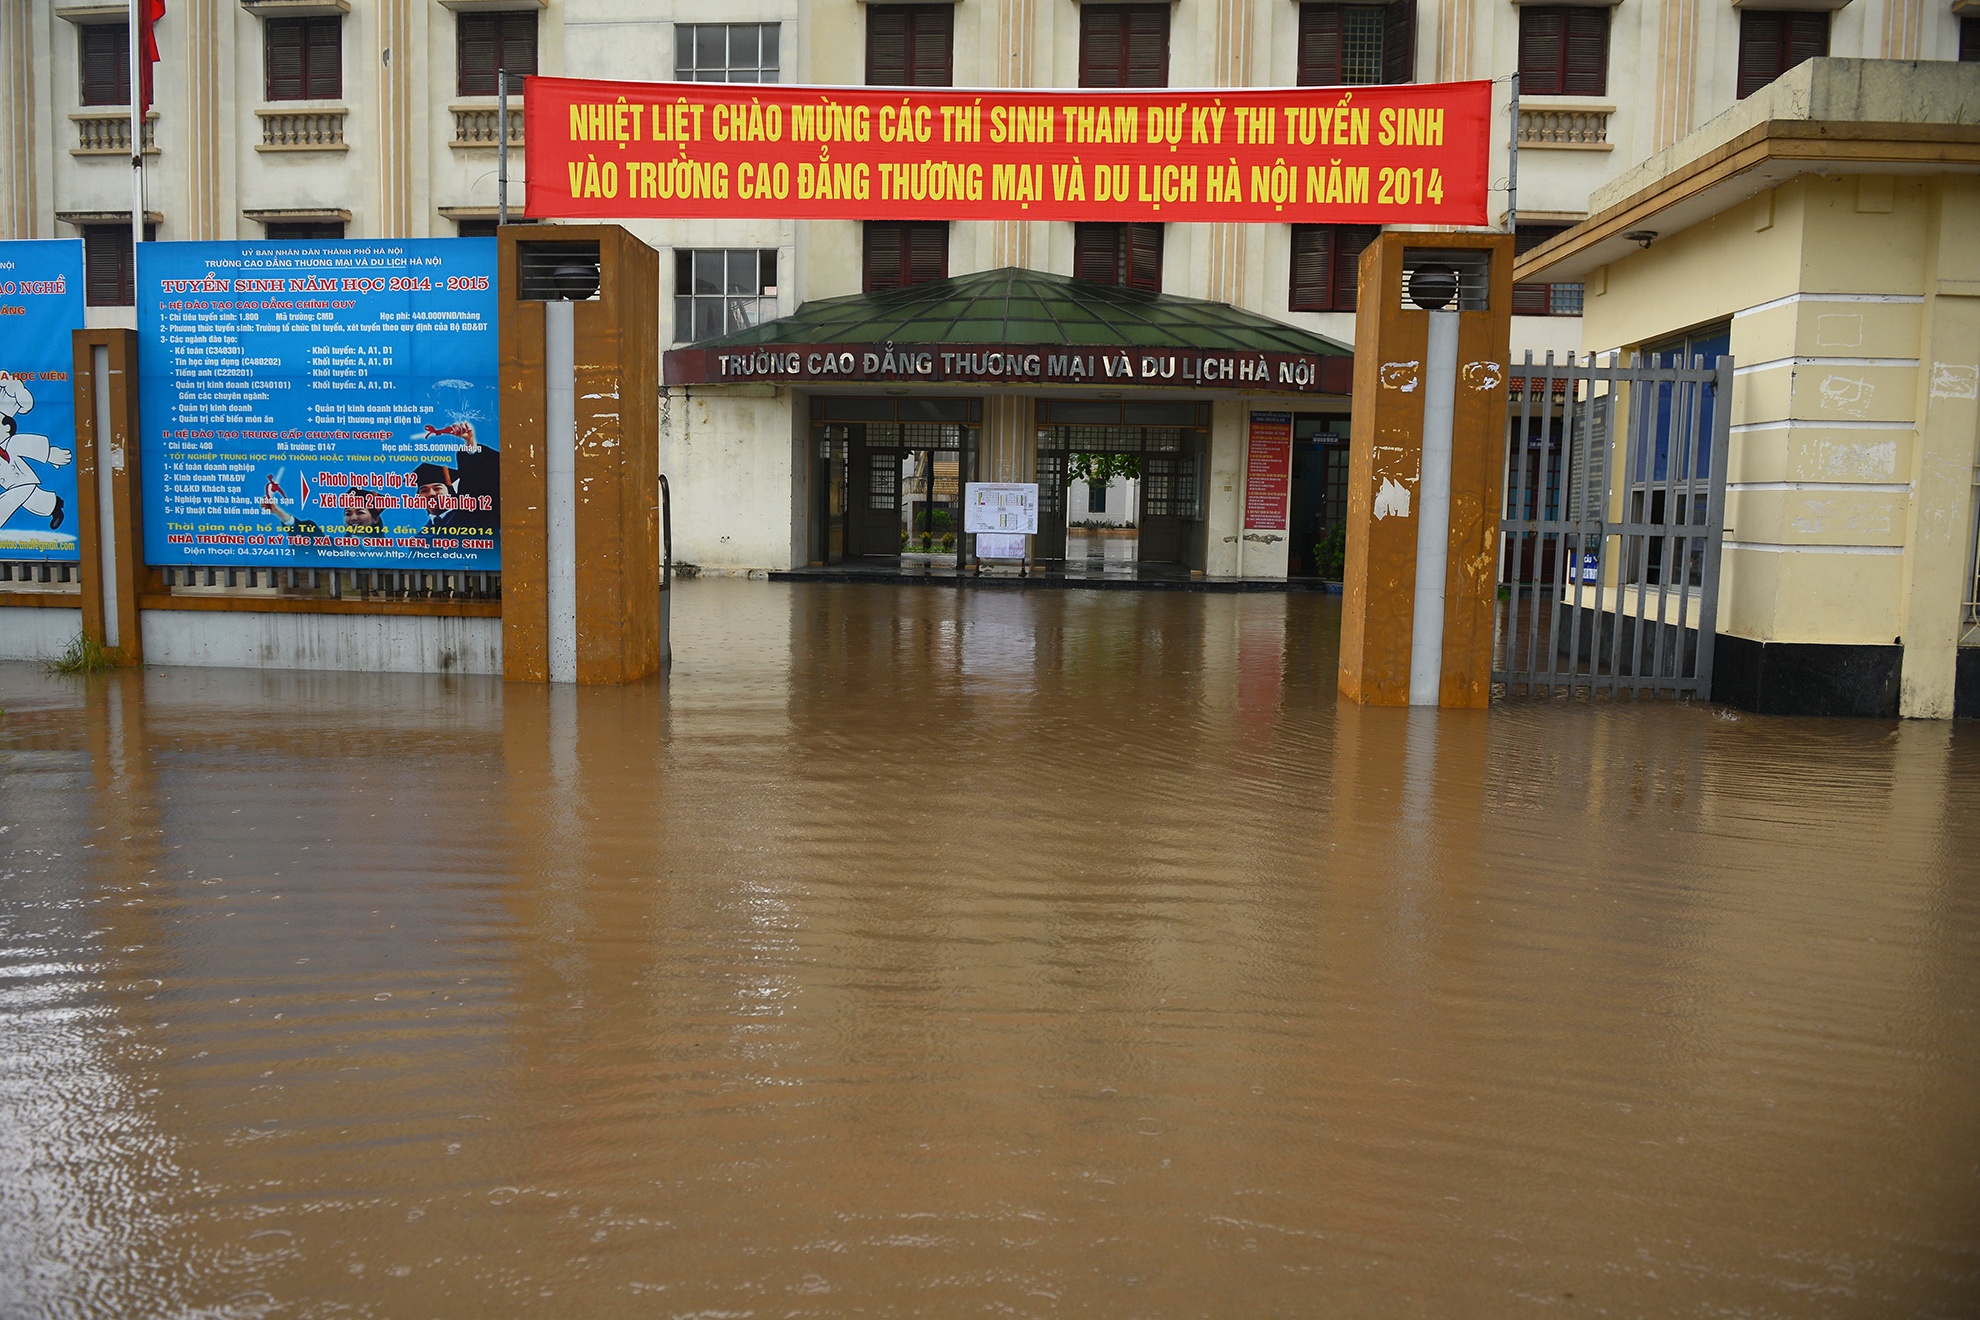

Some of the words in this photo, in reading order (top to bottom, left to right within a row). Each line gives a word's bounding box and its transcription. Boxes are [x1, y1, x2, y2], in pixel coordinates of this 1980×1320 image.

[570, 96, 644, 149] NHIỆT
[652, 97, 704, 149] LIỆT
[713, 97, 782, 142] CHÀO
[792, 96, 870, 142] MỪNG
[879, 98, 931, 142] CÁC
[940, 98, 981, 142] THÍ
[990, 106, 1053, 143] SINH
[1063, 106, 1137, 143] THAM
[1147, 102, 1188, 152] DỰ
[1192, 99, 1226, 144] KỲ
[1234, 108, 1275, 145] THI
[1284, 92, 1369, 146] TUYỂN
[1379, 108, 1444, 146] SINH
[568, 154, 617, 198] VÀO
[626, 152, 729, 199] TRƯỜNG
[738, 162, 789, 199] CAO
[797, 144, 869, 200] ĐẲNG
[878, 160, 982, 201] THƯƠNG
[992, 164, 1042, 209] MẠI
[1052, 157, 1085, 201] VÀ
[1094, 165, 1129, 202] DU
[1139, 165, 1197, 210] LỊCH
[1207, 158, 1242, 202] HÀ
[1251, 158, 1297, 210] NỘI
[1306, 158, 1369, 203] NĂM
[1378, 167, 1443, 204] 2014
[302, 248, 321, 256] DÂN
[323, 248, 352, 256] THÀNH
[354, 247, 372, 255] PHỐ
[388, 247, 403, 256] NỘI
[0, 261, 15, 271] NỘI
[205, 259, 242, 268] TRƯỜNG
[244, 260, 264, 268] CAO
[266, 256, 293, 268] ĐẲNG
[295, 259, 333, 267] THƯƠNG
[335, 259, 353, 268] MẠI
[355, 257, 369, 267] VÀ
[387, 258, 408, 267] LỊCH
[410, 257, 423, 266] HÀ
[426, 257, 442, 267] NỘI
[19, 273, 66, 295] NGHỀ
[161, 272, 230, 293] TUYỂN
[234, 279, 285, 292] SINH
[289, 275, 338, 292] NĂM
[341, 277, 385, 294] HỌC
[389, 277, 431, 291] 2014
[447, 276, 489, 291] 2015
[169, 300, 183, 311] HỆ
[184, 300, 209, 310] ĐÀO
[211, 301, 233, 311] TẠO
[235, 301, 259, 309] CAO
[261, 297, 293, 309] ĐẲNG
[295, 299, 329, 309] CHÍNH
[331, 300, 356, 309] QUY
[718, 348, 801, 375] TRƯỜNG
[807, 352, 855, 375] CAO
[863, 341, 932, 375] ĐẲNG
[941, 351, 1040, 377] THƯƠNG
[1048, 354, 1094, 382] MẠI
[1102, 350, 1134, 377] VÀ
[1141, 356, 1176, 378] DU
[1182, 358, 1233, 384] LỊCH
[1239, 355, 1270, 382] HÀ
[1279, 358, 1315, 389] NỘI
[175, 430, 188, 440] HỆ
[190, 430, 215, 438] ĐÀO
[216, 430, 239, 440] TẠO
[241, 430, 278, 439] TRUNG
[280, 428, 303, 439] CẤP
[305, 430, 350, 440] CHUYÊN
[352, 430, 393, 441] NGHIỆP
[188, 453, 217, 461] NGHIỆP
[250, 454, 267, 462] HỌC
[270, 453, 286, 461] PHỔ
[320, 454, 343, 462] HOẶC
[373, 454, 386, 463] ĐỘ
[420, 455, 452, 463] ĐƯƠNG
[318, 472, 348, 487] Photo
[349, 472, 369, 490] học
[370, 472, 384, 490] bạ
[385, 472, 402, 489] lớp
[404, 473, 418, 487] 12
[319, 493, 337, 508] Xét
[338, 490, 365, 508] điểm
[366, 493, 374, 509] 2
[374, 493, 400, 509] môn:
[402, 493, 428, 509] Toán
[437, 494, 458, 510] Văn
[459, 494, 476, 512] lớp
[478, 495, 492, 510] 12
[167, 523, 194, 531] Thời
[198, 523, 225, 533] gian
[229, 523, 253, 534] nộp
[257, 523, 272, 532] hồ
[276, 524, 294, 532] sơ:
[298, 524, 316, 533] Từ
[319, 525, 389, 534] 18/04/2014
[393, 525, 416, 535] đến
[421, 526, 493, 536] 31/10/2014
[168, 534, 194, 544] NHÀ
[196, 534, 245, 545] TRƯỜNG
[247, 535, 265, 545] CÓ
[286, 535, 311, 546] TÚC
[334, 537, 360, 547] CHO
[362, 537, 394, 547] SINH
[396, 536, 430, 549] VIÊN,
[432, 538, 459, 550] HỌC
[462, 539, 493, 549] SINH
[184, 548, 206, 556] Điện
[208, 548, 236, 557] thoại:
[238, 548, 296, 557] 04.37641121
[317, 549, 478, 560] Website:www.http://hcct.edu.vn
